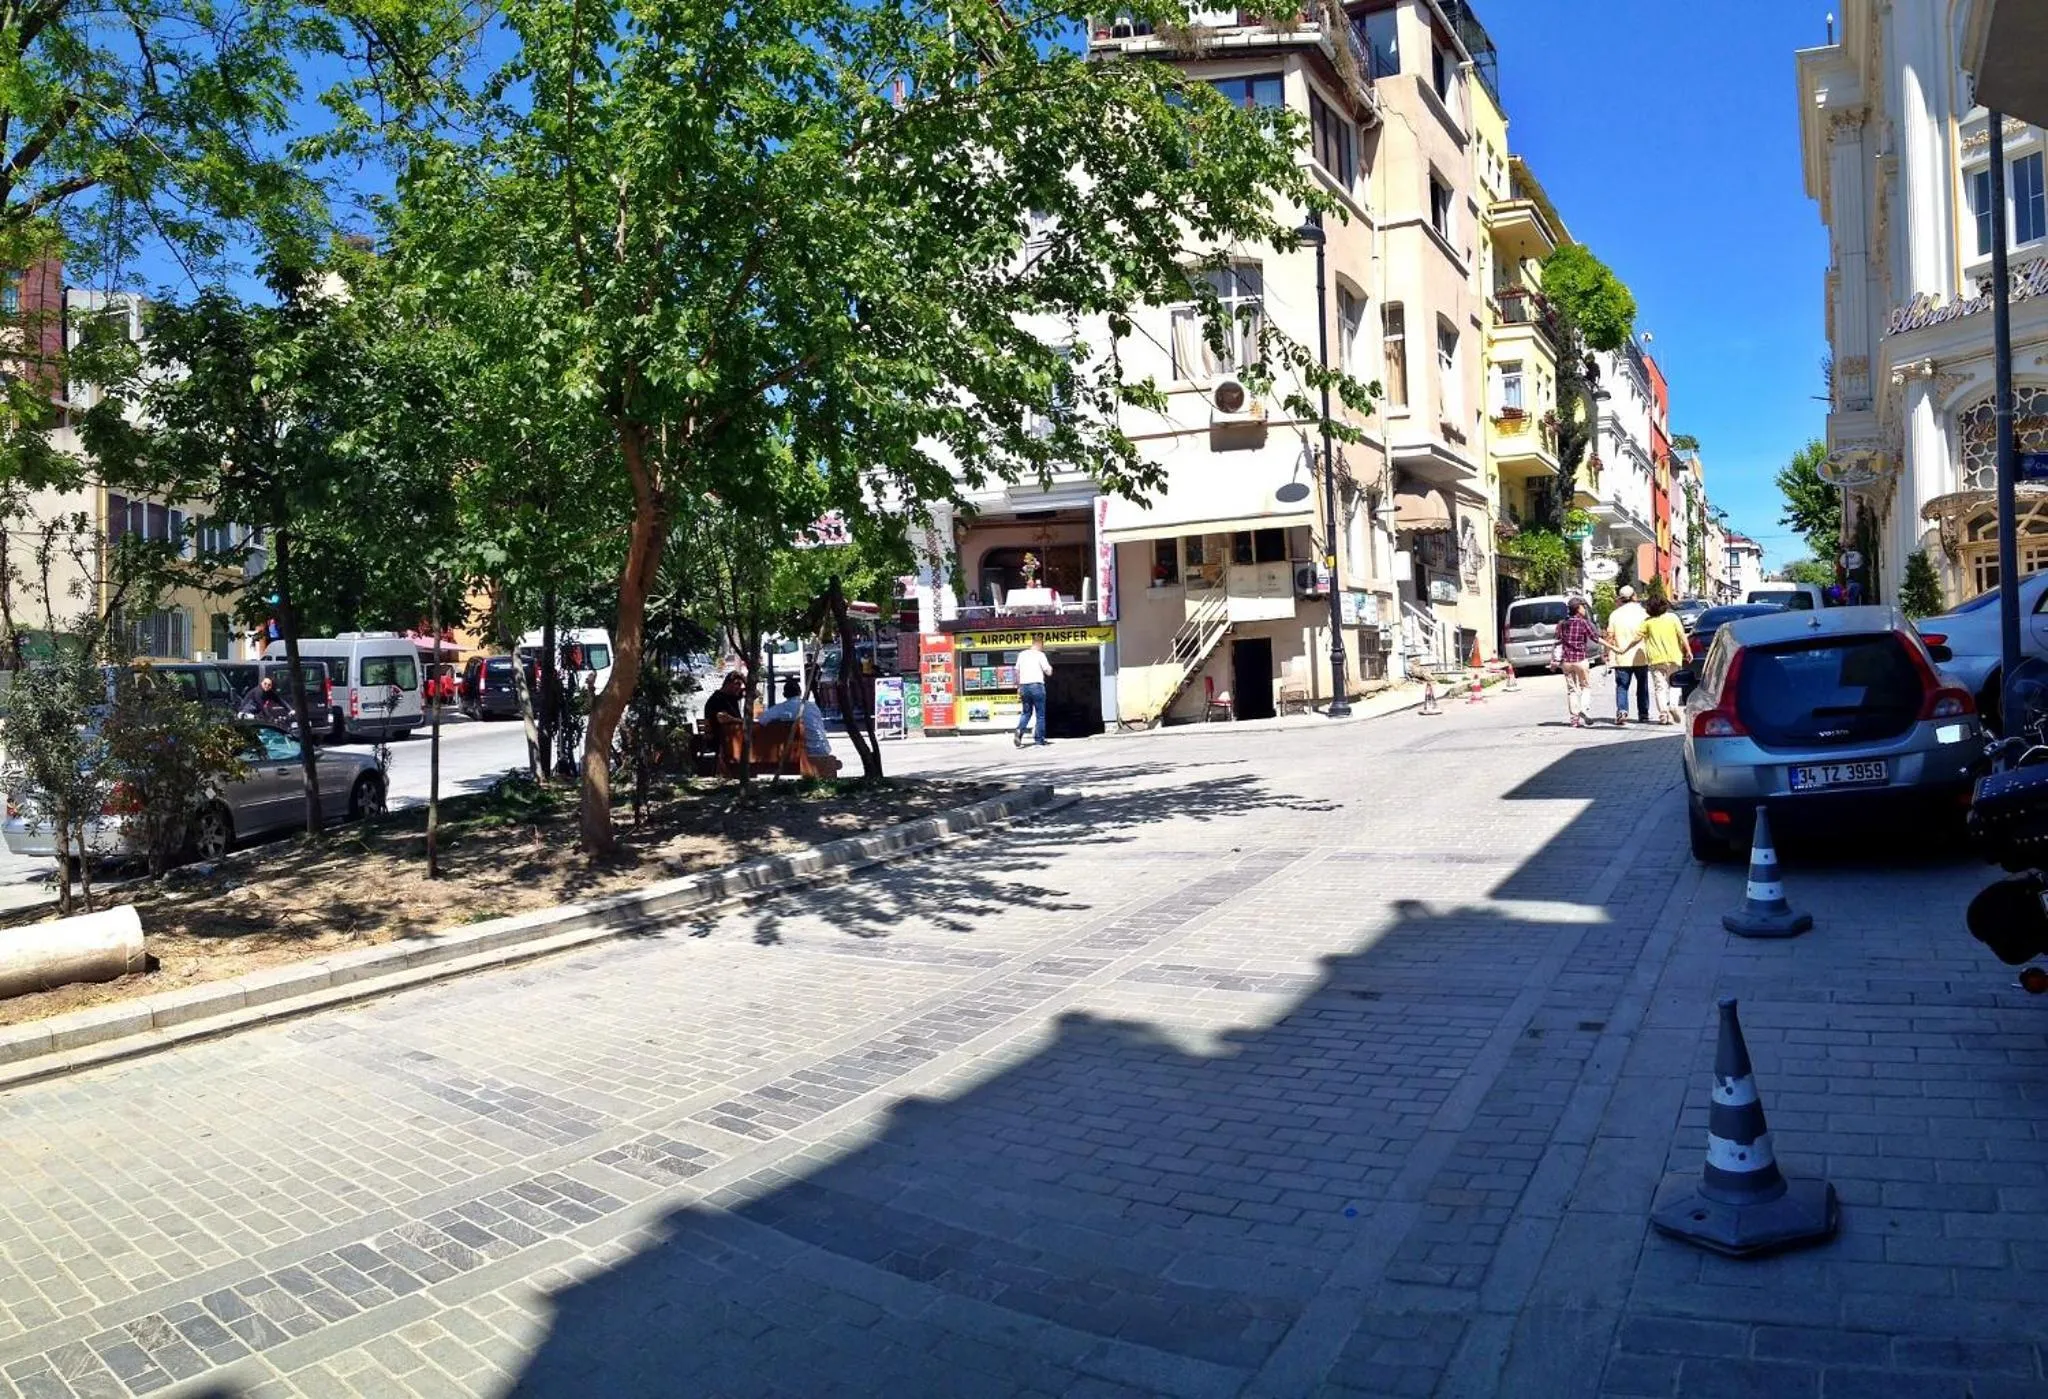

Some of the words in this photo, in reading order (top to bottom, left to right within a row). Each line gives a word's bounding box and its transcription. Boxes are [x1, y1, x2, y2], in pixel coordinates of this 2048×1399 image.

[981, 632, 1026, 645] AIRPORT
[1030, 630, 1088, 643] TRANSFER
[1799, 768, 1816, 784] 34
[1822, 765, 1841, 782] TZ
[1847, 762, 1883, 780] 3959
